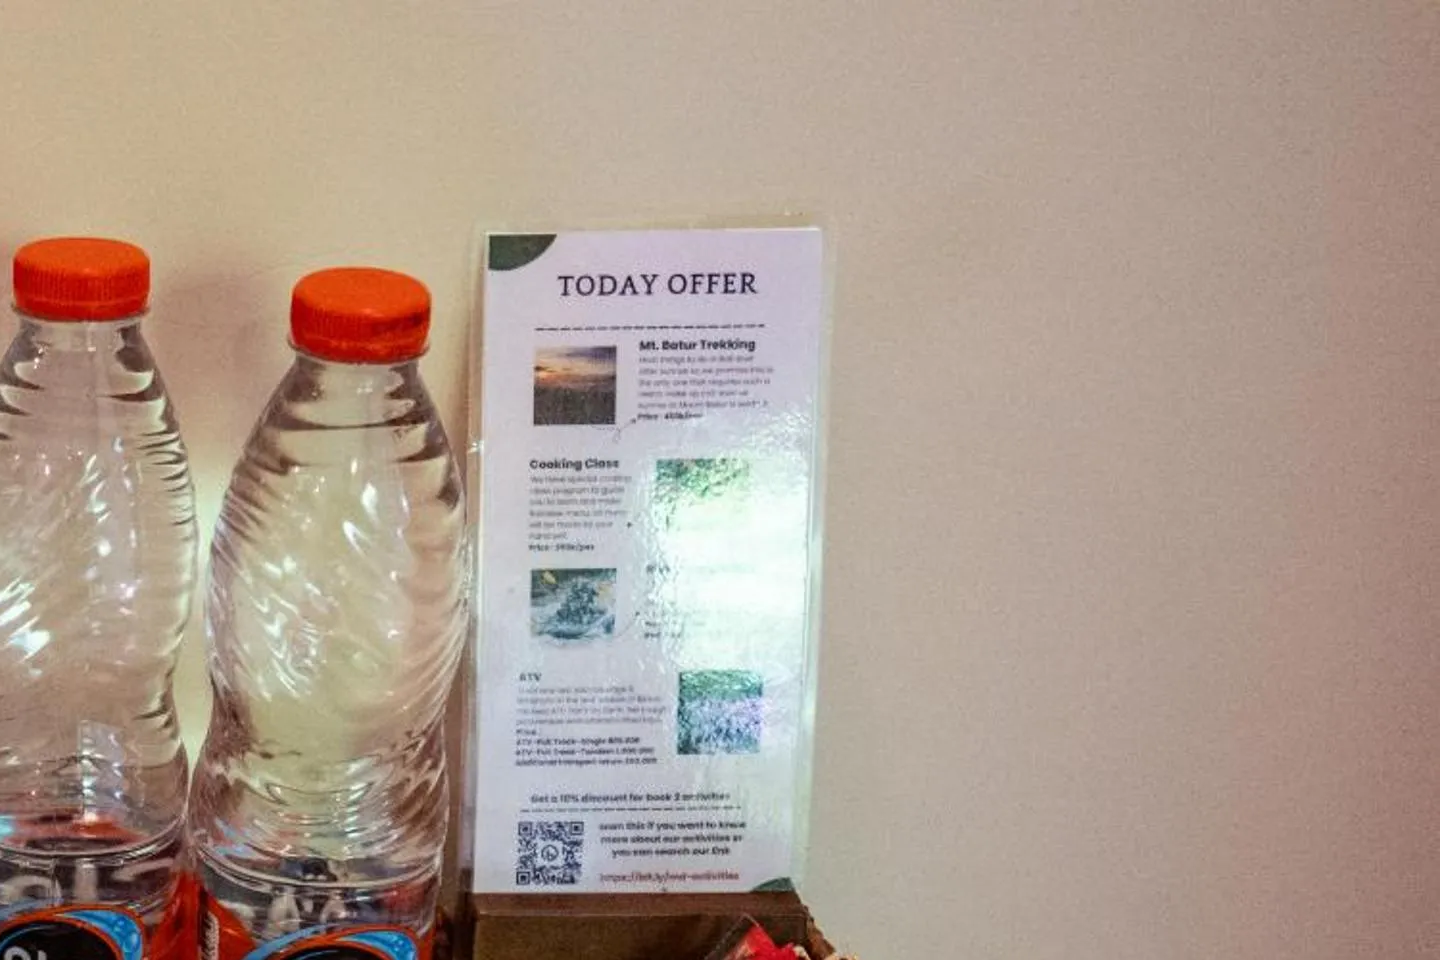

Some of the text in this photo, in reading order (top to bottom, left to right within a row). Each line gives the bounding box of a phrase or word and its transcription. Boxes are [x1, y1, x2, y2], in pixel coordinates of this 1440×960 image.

[557, 272, 758, 297] TODAY OFFER
[639, 338, 756, 352] Mt. Batur Trekking
[529, 458, 619, 471] Cooking Class
